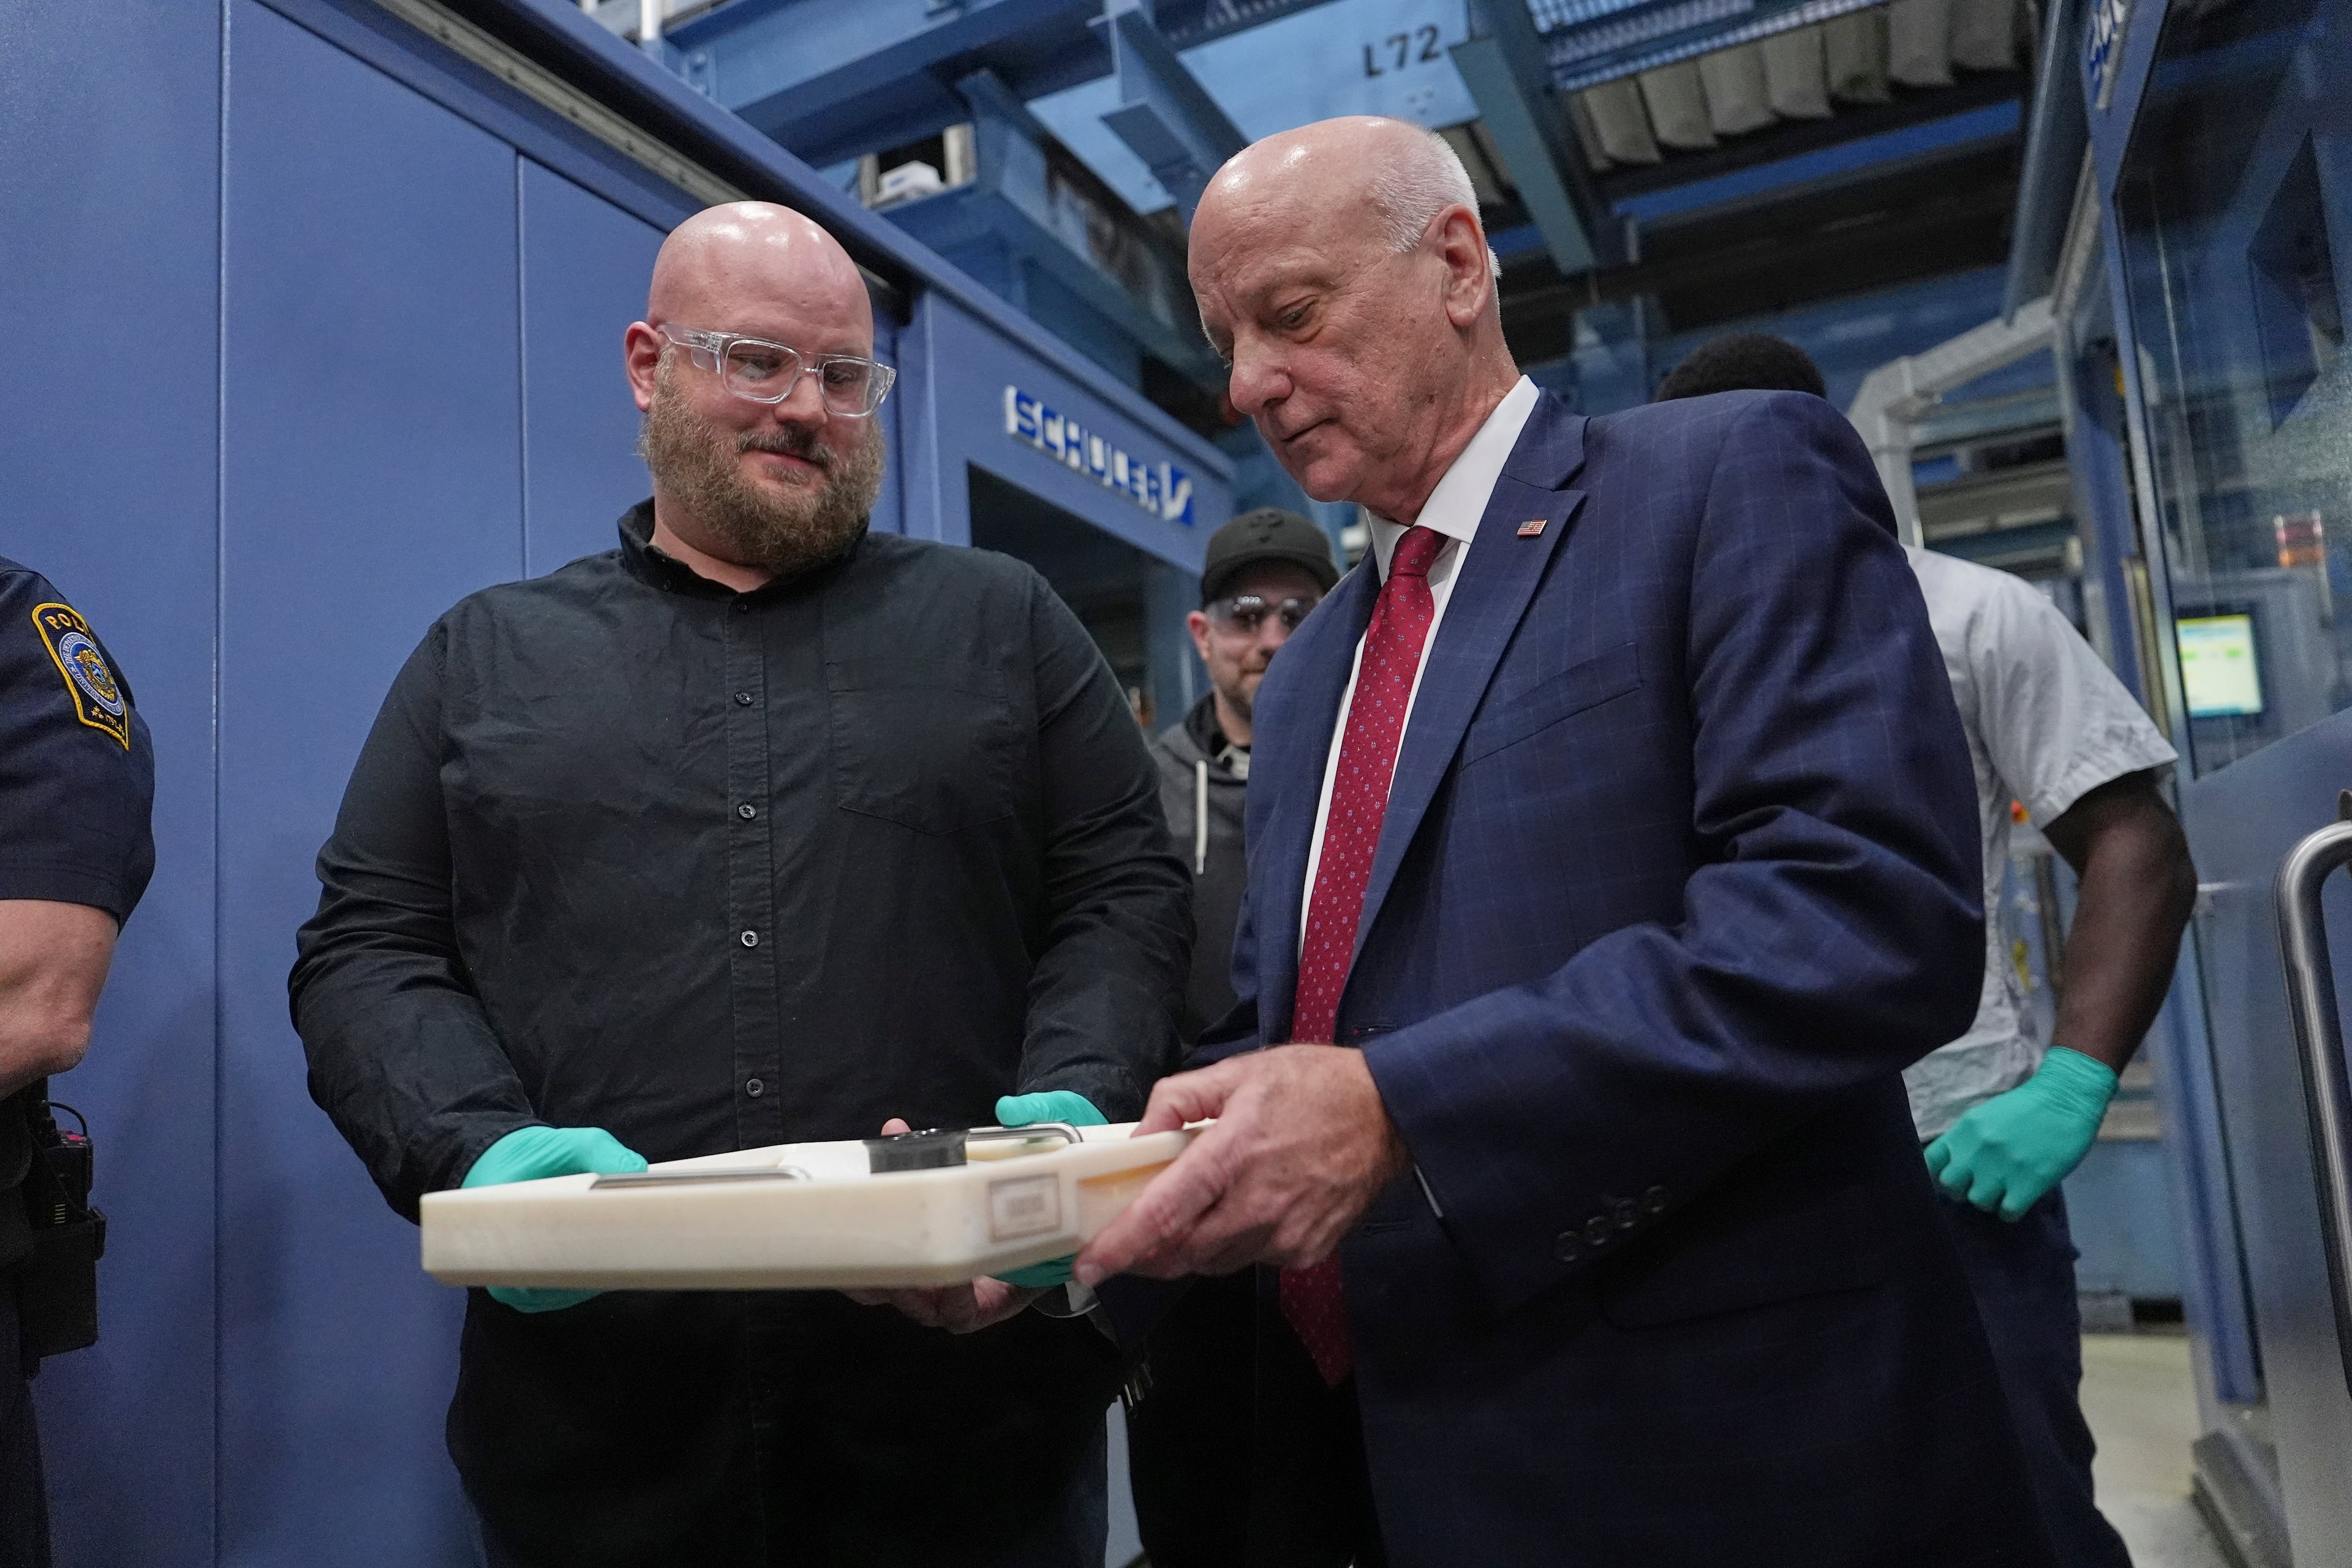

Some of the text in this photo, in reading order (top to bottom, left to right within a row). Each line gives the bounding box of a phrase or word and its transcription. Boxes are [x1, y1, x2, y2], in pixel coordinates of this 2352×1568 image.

[1363, 24, 1441, 78] L72
[1011, 387, 1160, 514] SCHULER
[45, 613, 88, 635] POLI
